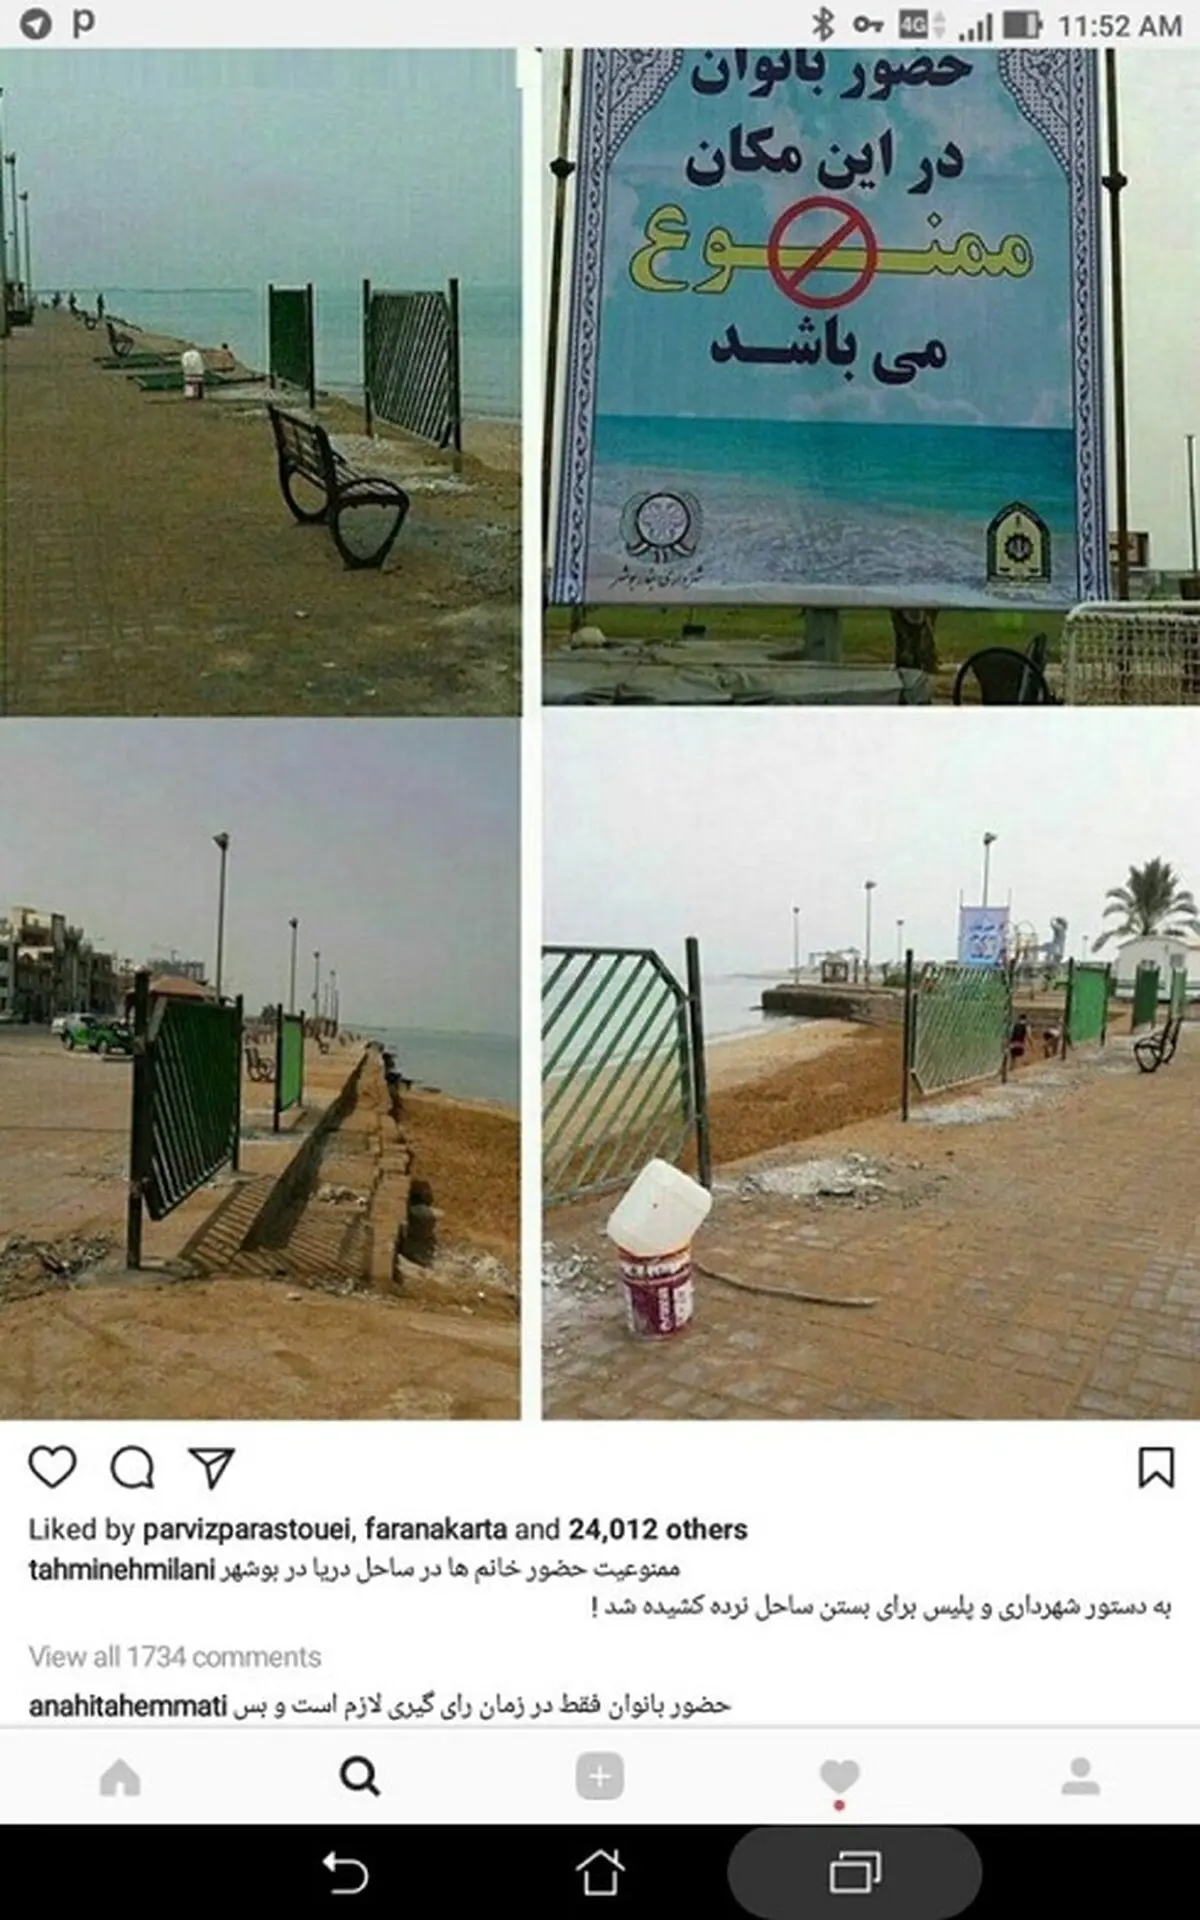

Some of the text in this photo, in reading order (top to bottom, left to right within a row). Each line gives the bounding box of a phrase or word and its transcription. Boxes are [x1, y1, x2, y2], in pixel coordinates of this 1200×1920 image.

[901, 14, 926, 34] 4G
[1059, 14, 1183, 38] 11:52 AM
[691, 48, 974, 101] حضور بانوان
[685, 125, 964, 194] در این مکان
[628, 203, 1034, 295] ممنوع
[710, 314, 948, 385] می باشد
[29, 1515, 749, 1547] Liked by parvizparastouei, faranakarta and 24,012 others
[28, 1555, 216, 1582] tahminehmilani
[219, 1556, 682, 1585] ممنوعیت حضور خانم ها در ساحل دریا در بوشهر
[604, 1598, 638, 1616] شد
[642, 1593, 707, 1620] کشیده
[709, 1596, 750, 1621] نرده
[755, 1593, 815, 1622] ساحل
[819, 1600, 871, 1622] بستن
[876, 1593, 918, 1622] برای
[922, 1593, 976, 1622] پلیس
[980, 1602, 993, 1620] و
[998, 1593, 1081, 1622] شهرداری
[1084, 1600, 1147, 1621] دستور
[1153, 1600, 1172, 1620] به
[29, 1644, 323, 1669] View all 1734 comments
[28, 1692, 227, 1719] anahitahemmati
[232, 1690, 733, 1721] حضور بانوان فقط در زمان رای گیری لازم است و بس
